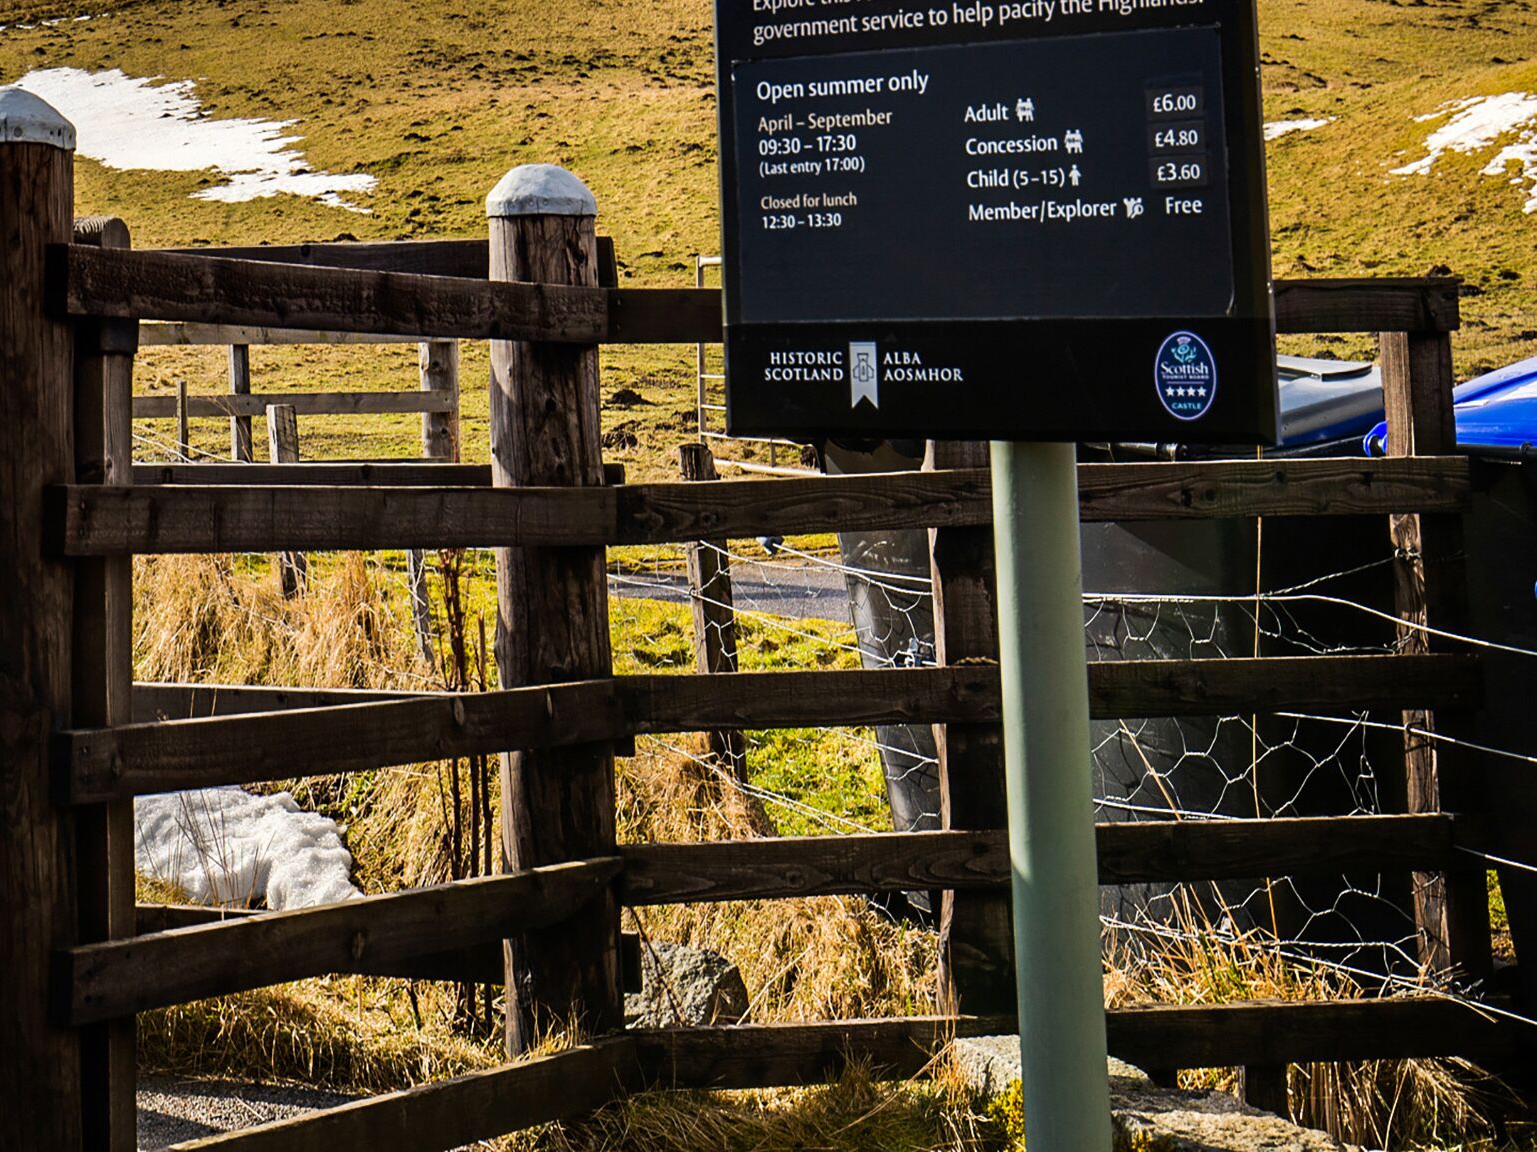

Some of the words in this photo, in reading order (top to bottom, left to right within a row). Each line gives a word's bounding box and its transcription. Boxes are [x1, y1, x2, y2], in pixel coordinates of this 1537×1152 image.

[754, 16, 857, 45] government
[862, 9, 923, 31] service
[928, 9, 947, 25] to
[953, 1, 993, 27] help
[757, 82, 804, 104] Open
[809, 78, 884, 96] summer
[889, 69, 928, 94] only
[965, 103, 1009, 122] Adult
[1154, 94, 1196, 112] £6.00
[758, 114, 792, 135] April
[808, 109, 892, 132] September
[759, 138, 801, 155] 09:30
[817, 134, 856, 151] 17:30
[966, 135, 1057, 155] Concession
[1155, 129, 1198, 147] £4.80
[760, 162, 788, 177] (Last
[790, 161, 821, 175] entry
[825, 156, 865, 172] 17:00)
[967, 169, 1009, 187] Child
[1158, 163, 1200, 181] £3.60
[761, 195, 800, 209] Closed
[803, 194, 820, 207] for
[823, 192, 857, 206] lunch
[969, 199, 1117, 222] Member/Explorer
[1166, 197, 1202, 214] Free
[763, 215, 795, 229] 12:30
[808, 213, 841, 227] 13:30
[770, 352, 843, 365] HISTORIC
[883, 352, 921, 365] ALBA
[1161, 361, 1209, 375] Scottish
[764, 368, 844, 381] SCOTLAND
[884, 368, 963, 381] AOSMHOR
